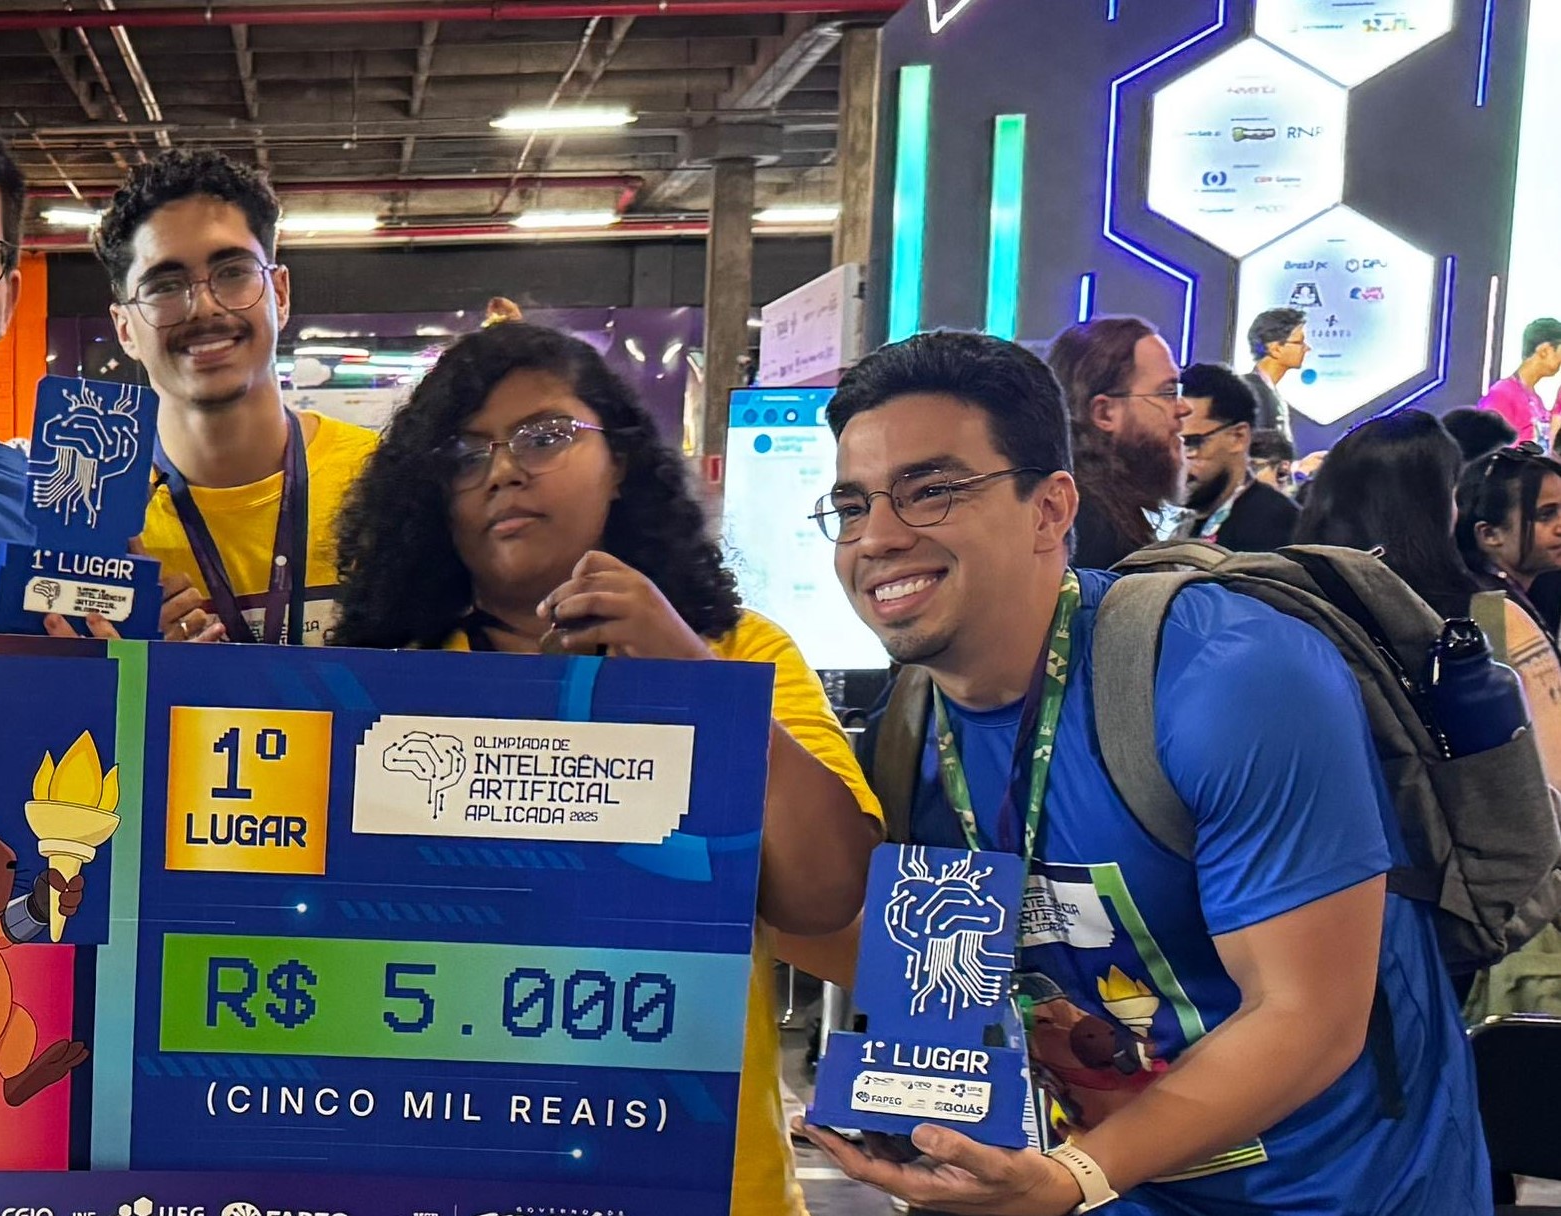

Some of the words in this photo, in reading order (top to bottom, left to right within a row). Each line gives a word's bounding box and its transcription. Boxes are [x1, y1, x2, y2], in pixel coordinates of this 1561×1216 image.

[58, 552, 134, 581] LUGAR
[552, 739, 570, 750] DE
[474, 753, 654, 780] INTELIGÊNCIA
[469, 779, 620, 804] ARTIFICIAL
[465, 805, 564, 824] APLICADA
[569, 811, 598, 822] 2025
[186, 813, 306, 847] LUGAR
[206, 956, 318, 1029] R$
[382, 963, 676, 1043] 5.000
[893, 1043, 989, 1075] LUGAR
[206, 1082, 374, 1117] (CINCO
[403, 1091, 481, 1122] MIL
[510, 1097, 668, 1132] REAIS)
[871, 1095, 902, 1105] FAPEG
[516, 1206, 589, 1215] GOVERNO
